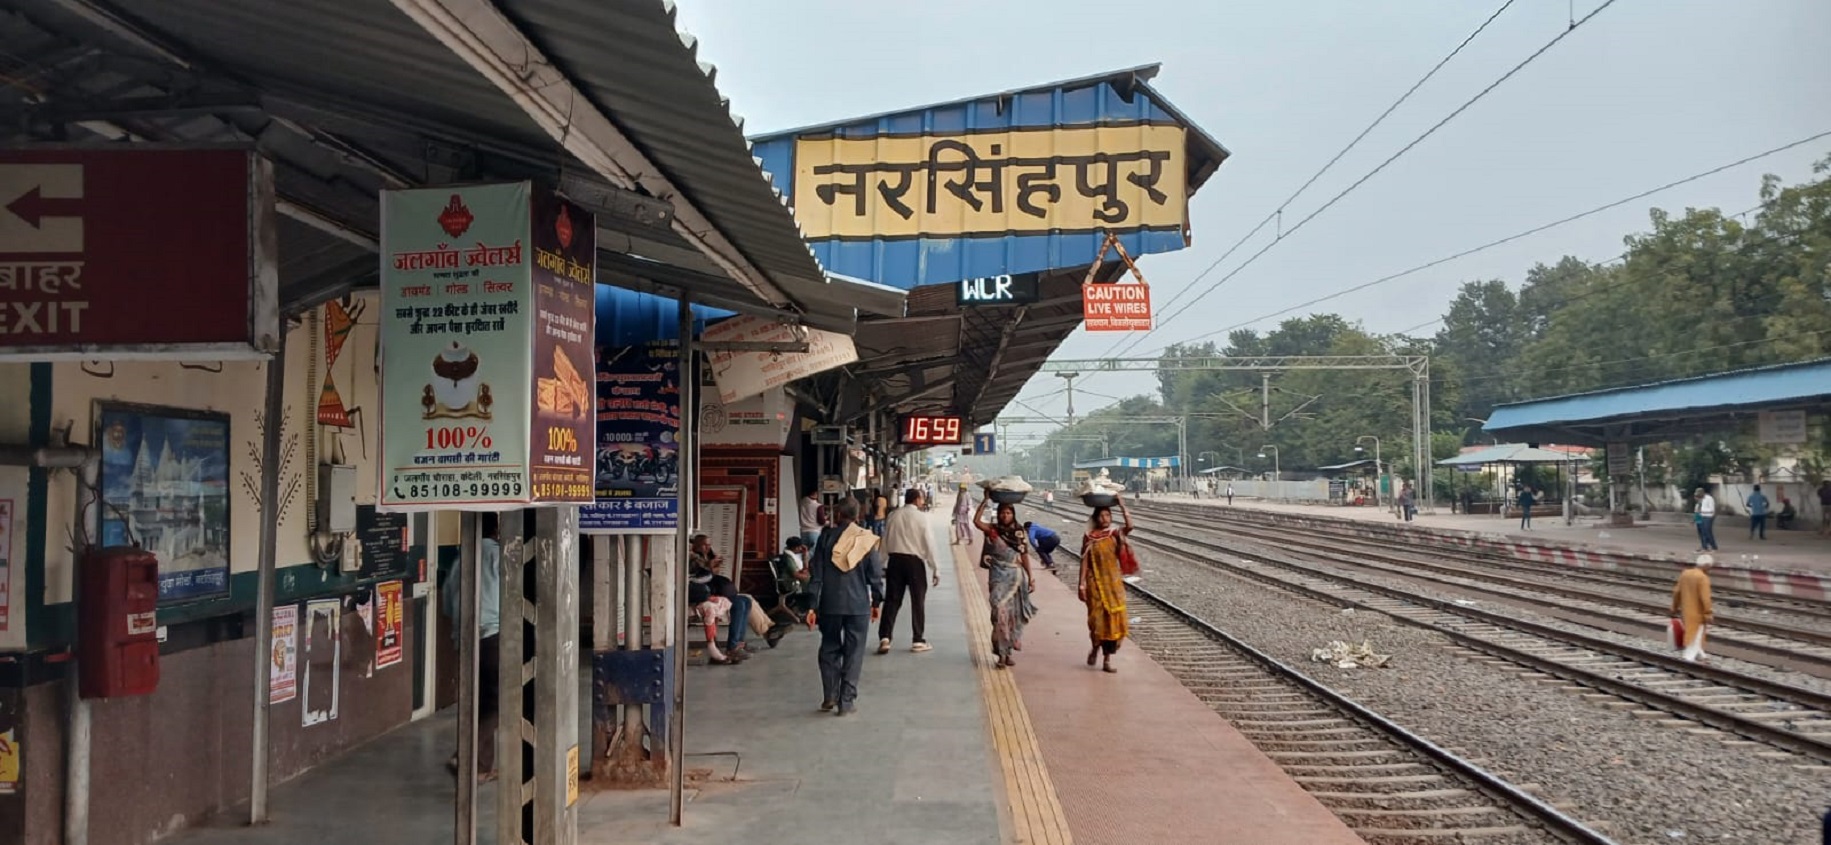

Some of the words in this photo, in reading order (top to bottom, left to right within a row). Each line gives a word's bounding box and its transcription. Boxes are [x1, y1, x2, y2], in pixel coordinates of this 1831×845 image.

[813, 140, 1170, 223] नरसिंहपुर
[393, 242, 460, 271] जलगाँव
[463, 239, 522, 267] ज्वेलर्स
[0, 261, 86, 294] बाहर
[446, 283, 469, 295] गोल्ड
[483, 281, 514, 293] सिल्वर
[963, 275, 1014, 300] WCR
[1086, 286, 1145, 300] CAUTION
[396, 306, 413, 319] सबसे
[433, 307, 444, 318] 22
[1088, 302, 1112, 314] LIVE
[1113, 302, 1148, 314] WIRES
[410, 319, 423, 335] और
[426, 323, 447, 334] अपना
[425, 426, 492, 449] 100%
[548, 427, 578, 452] 100%
[980, 435, 989, 452] 1
[414, 456, 435, 465] वजन
[438, 452, 463, 464] वापसी
[464, 452, 475, 463] की
[477, 451, 500, 463] गारंटी
[410, 483, 522, 498] 85108-99999
[634, 500, 669, 511] बजाज
